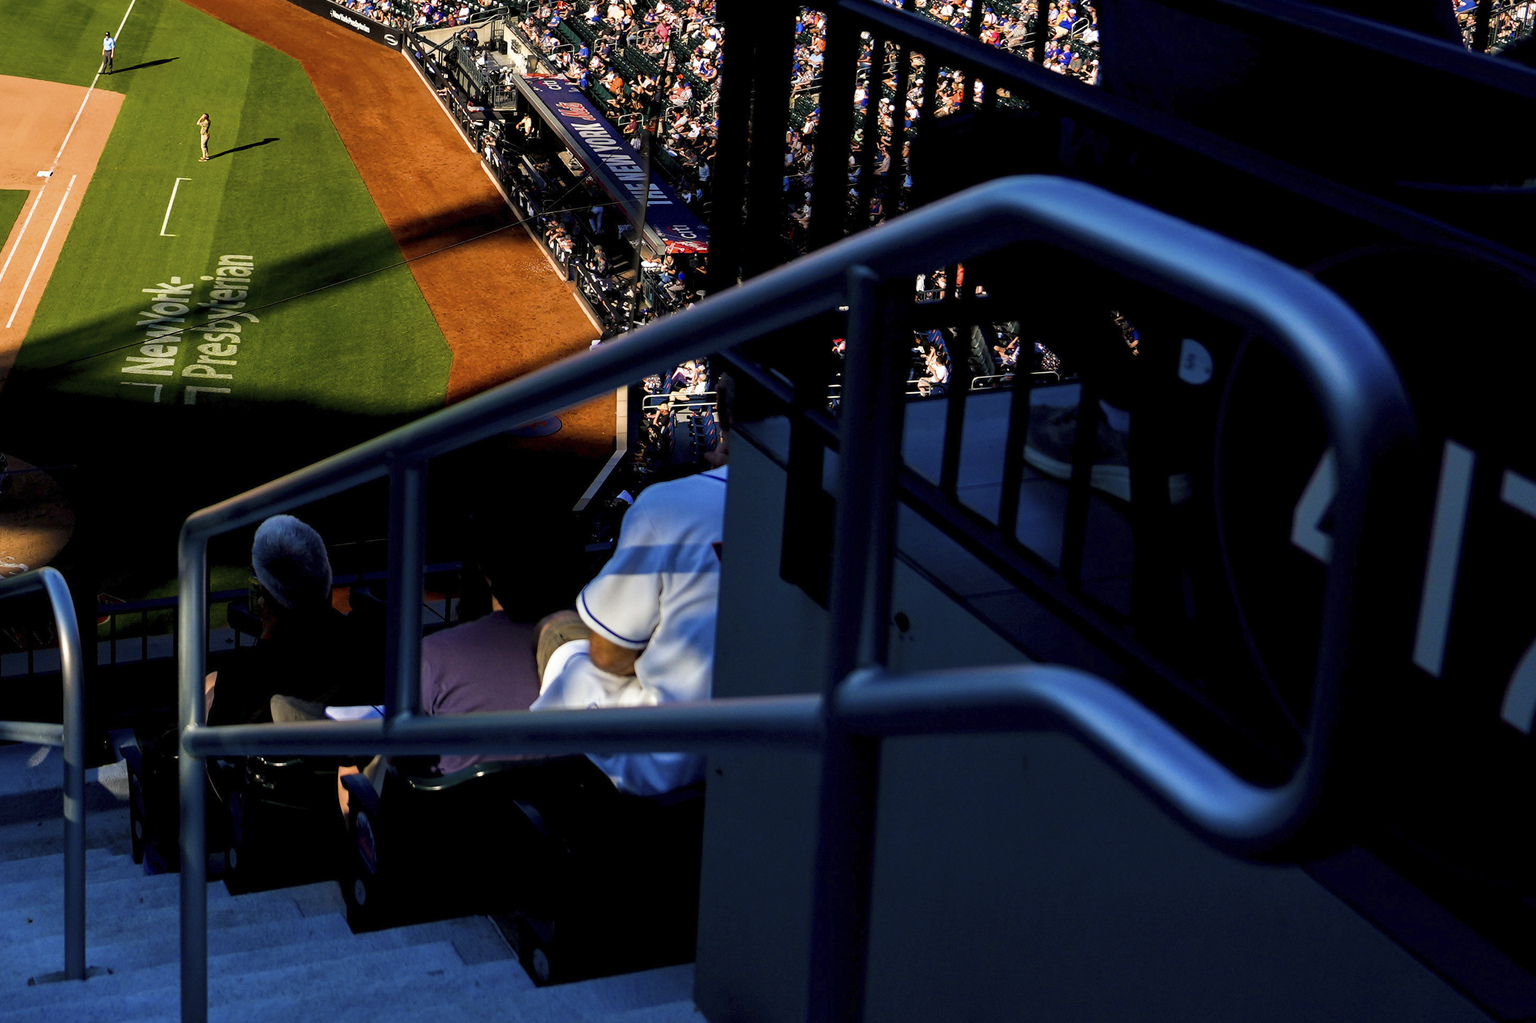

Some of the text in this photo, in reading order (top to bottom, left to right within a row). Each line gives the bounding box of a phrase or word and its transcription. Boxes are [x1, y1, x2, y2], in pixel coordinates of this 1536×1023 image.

[571, 122, 623, 153] YORK
[597, 154, 647, 181] NEW
[181, 254, 260, 380] Presbyterian
